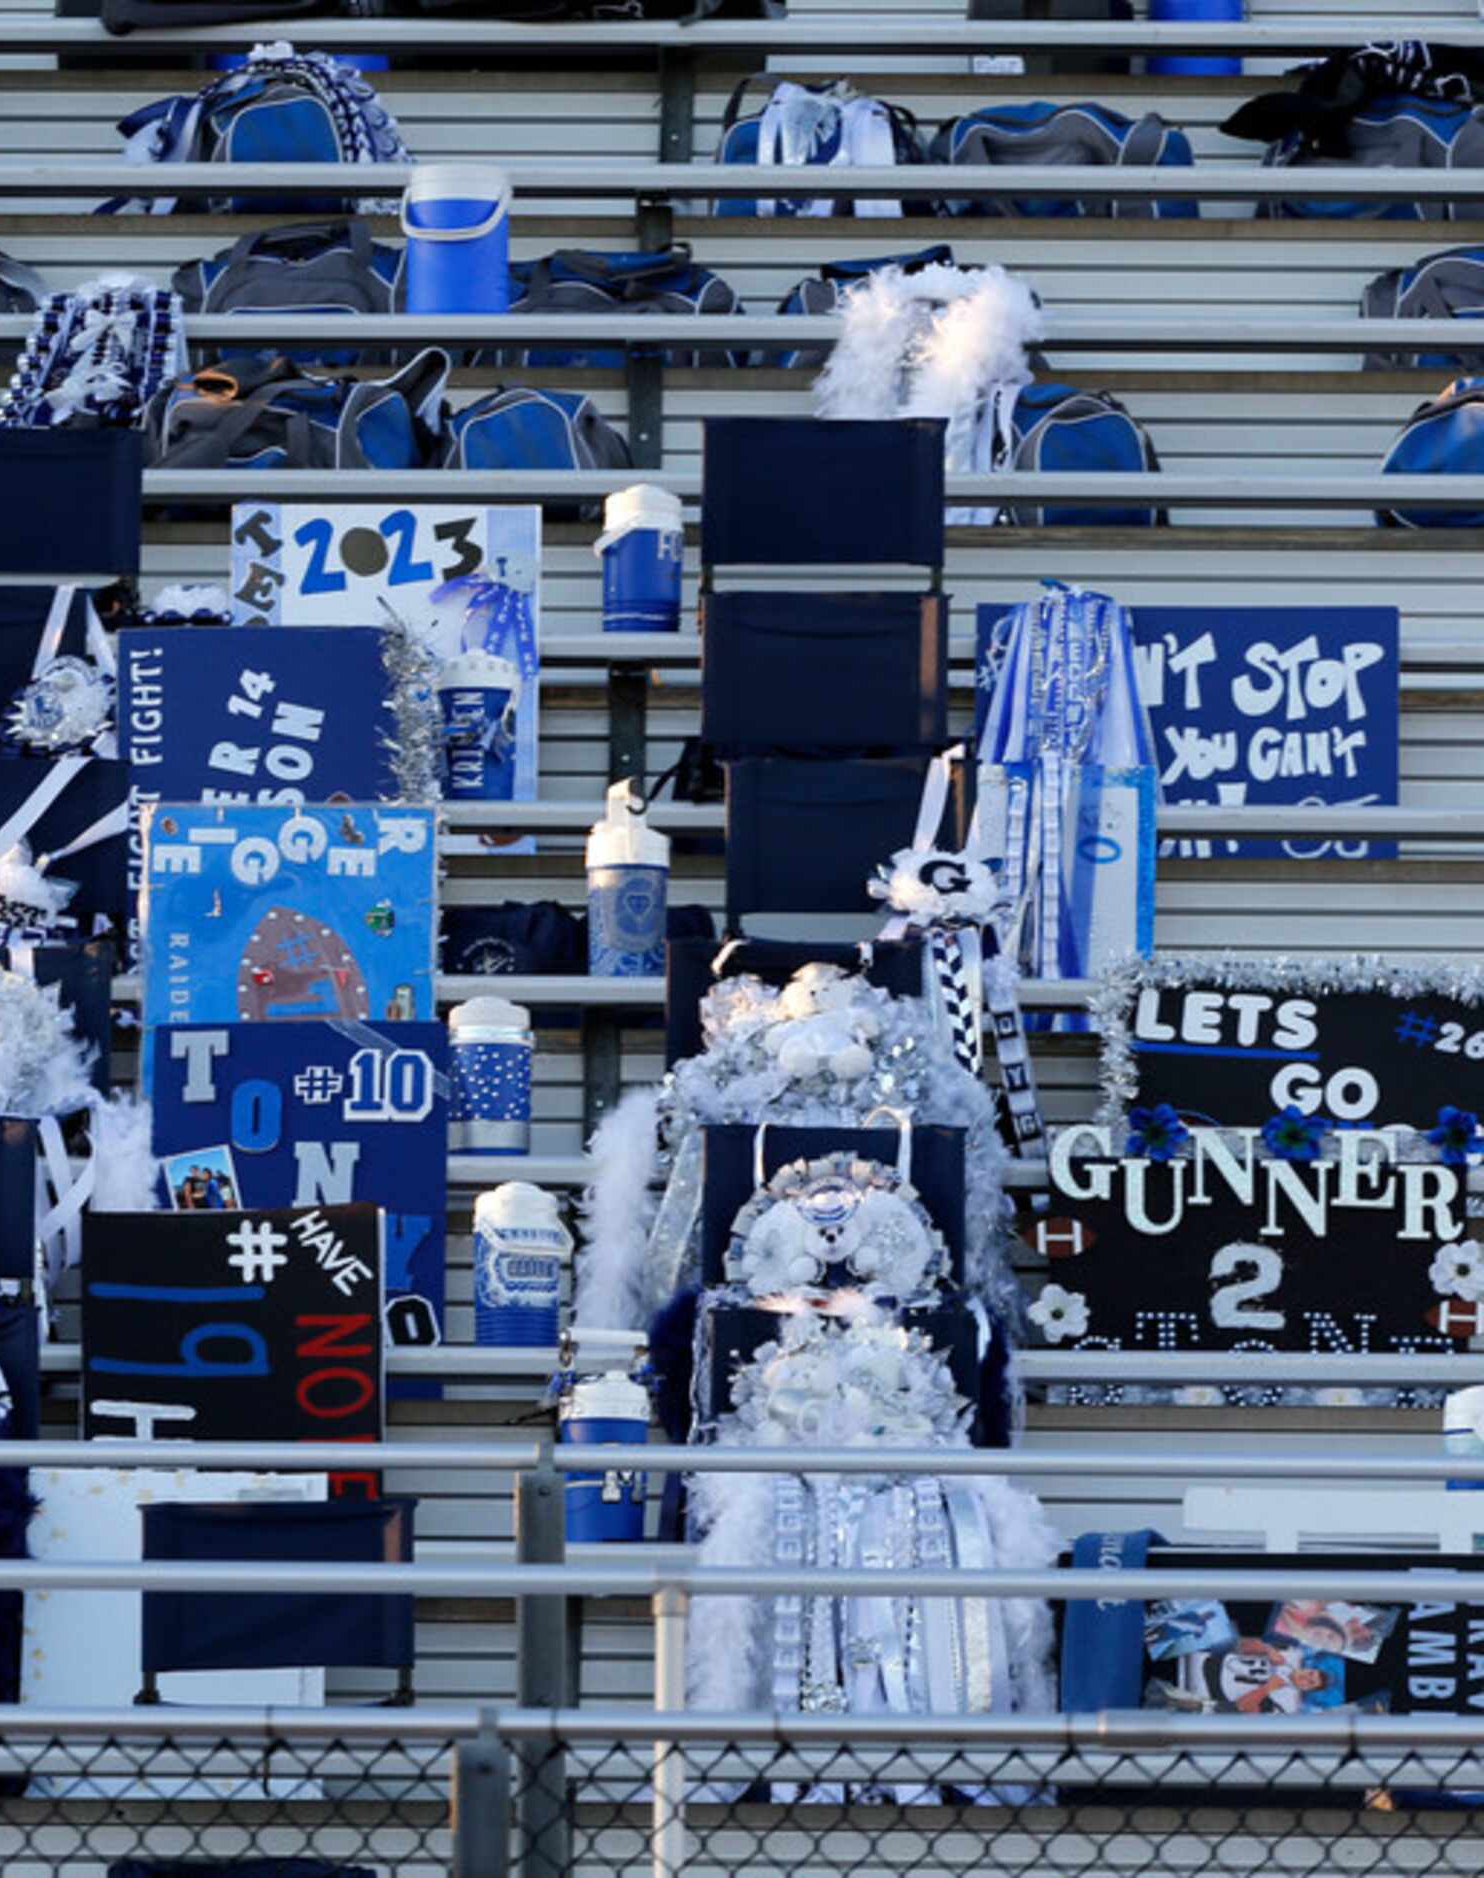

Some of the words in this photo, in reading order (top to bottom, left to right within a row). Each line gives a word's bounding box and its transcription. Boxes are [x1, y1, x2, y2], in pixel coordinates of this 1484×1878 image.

[294, 510, 484, 595] 2023
[129, 648, 164, 765] FIGHT!
[227, 669, 276, 719] 14
[1231, 634, 1385, 721] STOP
[1161, 726, 1239, 785] YOU
[1248, 726, 1367, 782] CAN'T
[919, 860, 972, 894] G
[1134, 989, 1318, 1051] LETS
[293, 1048, 434, 1122] #10
[1270, 1062, 1380, 1121] GO
[1050, 1124, 1465, 1241] GUNNER
[290, 1210, 374, 1296] HAVE
[1209, 1242, 1287, 1330] 2
